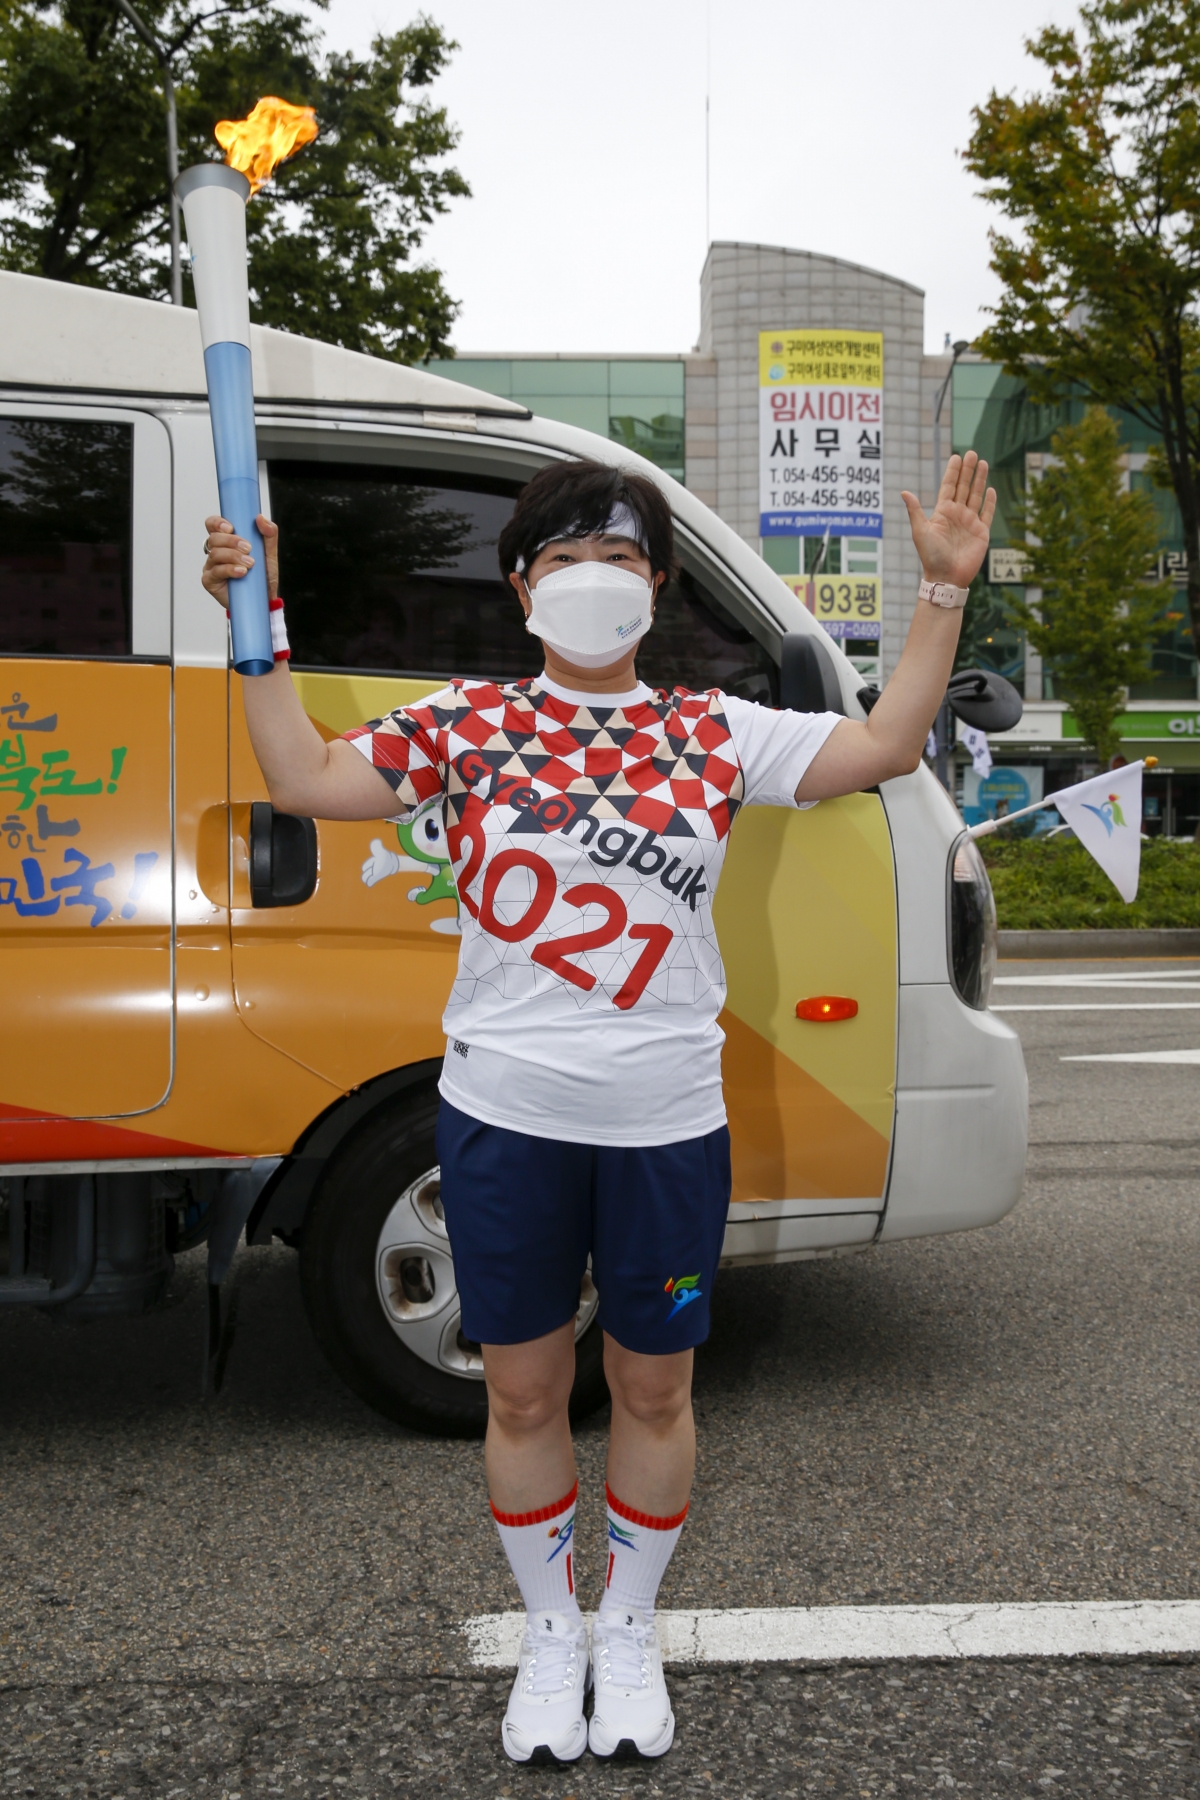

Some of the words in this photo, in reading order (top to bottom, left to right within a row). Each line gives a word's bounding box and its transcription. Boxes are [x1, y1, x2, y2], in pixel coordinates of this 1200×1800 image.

[769, 391, 880, 423] 임시이전
[0, 691, 58, 732] 운
[0, 803, 81, 853] 한
[456, 748, 708, 912] Gyeongbuk
[446, 818, 674, 1010] 2021
